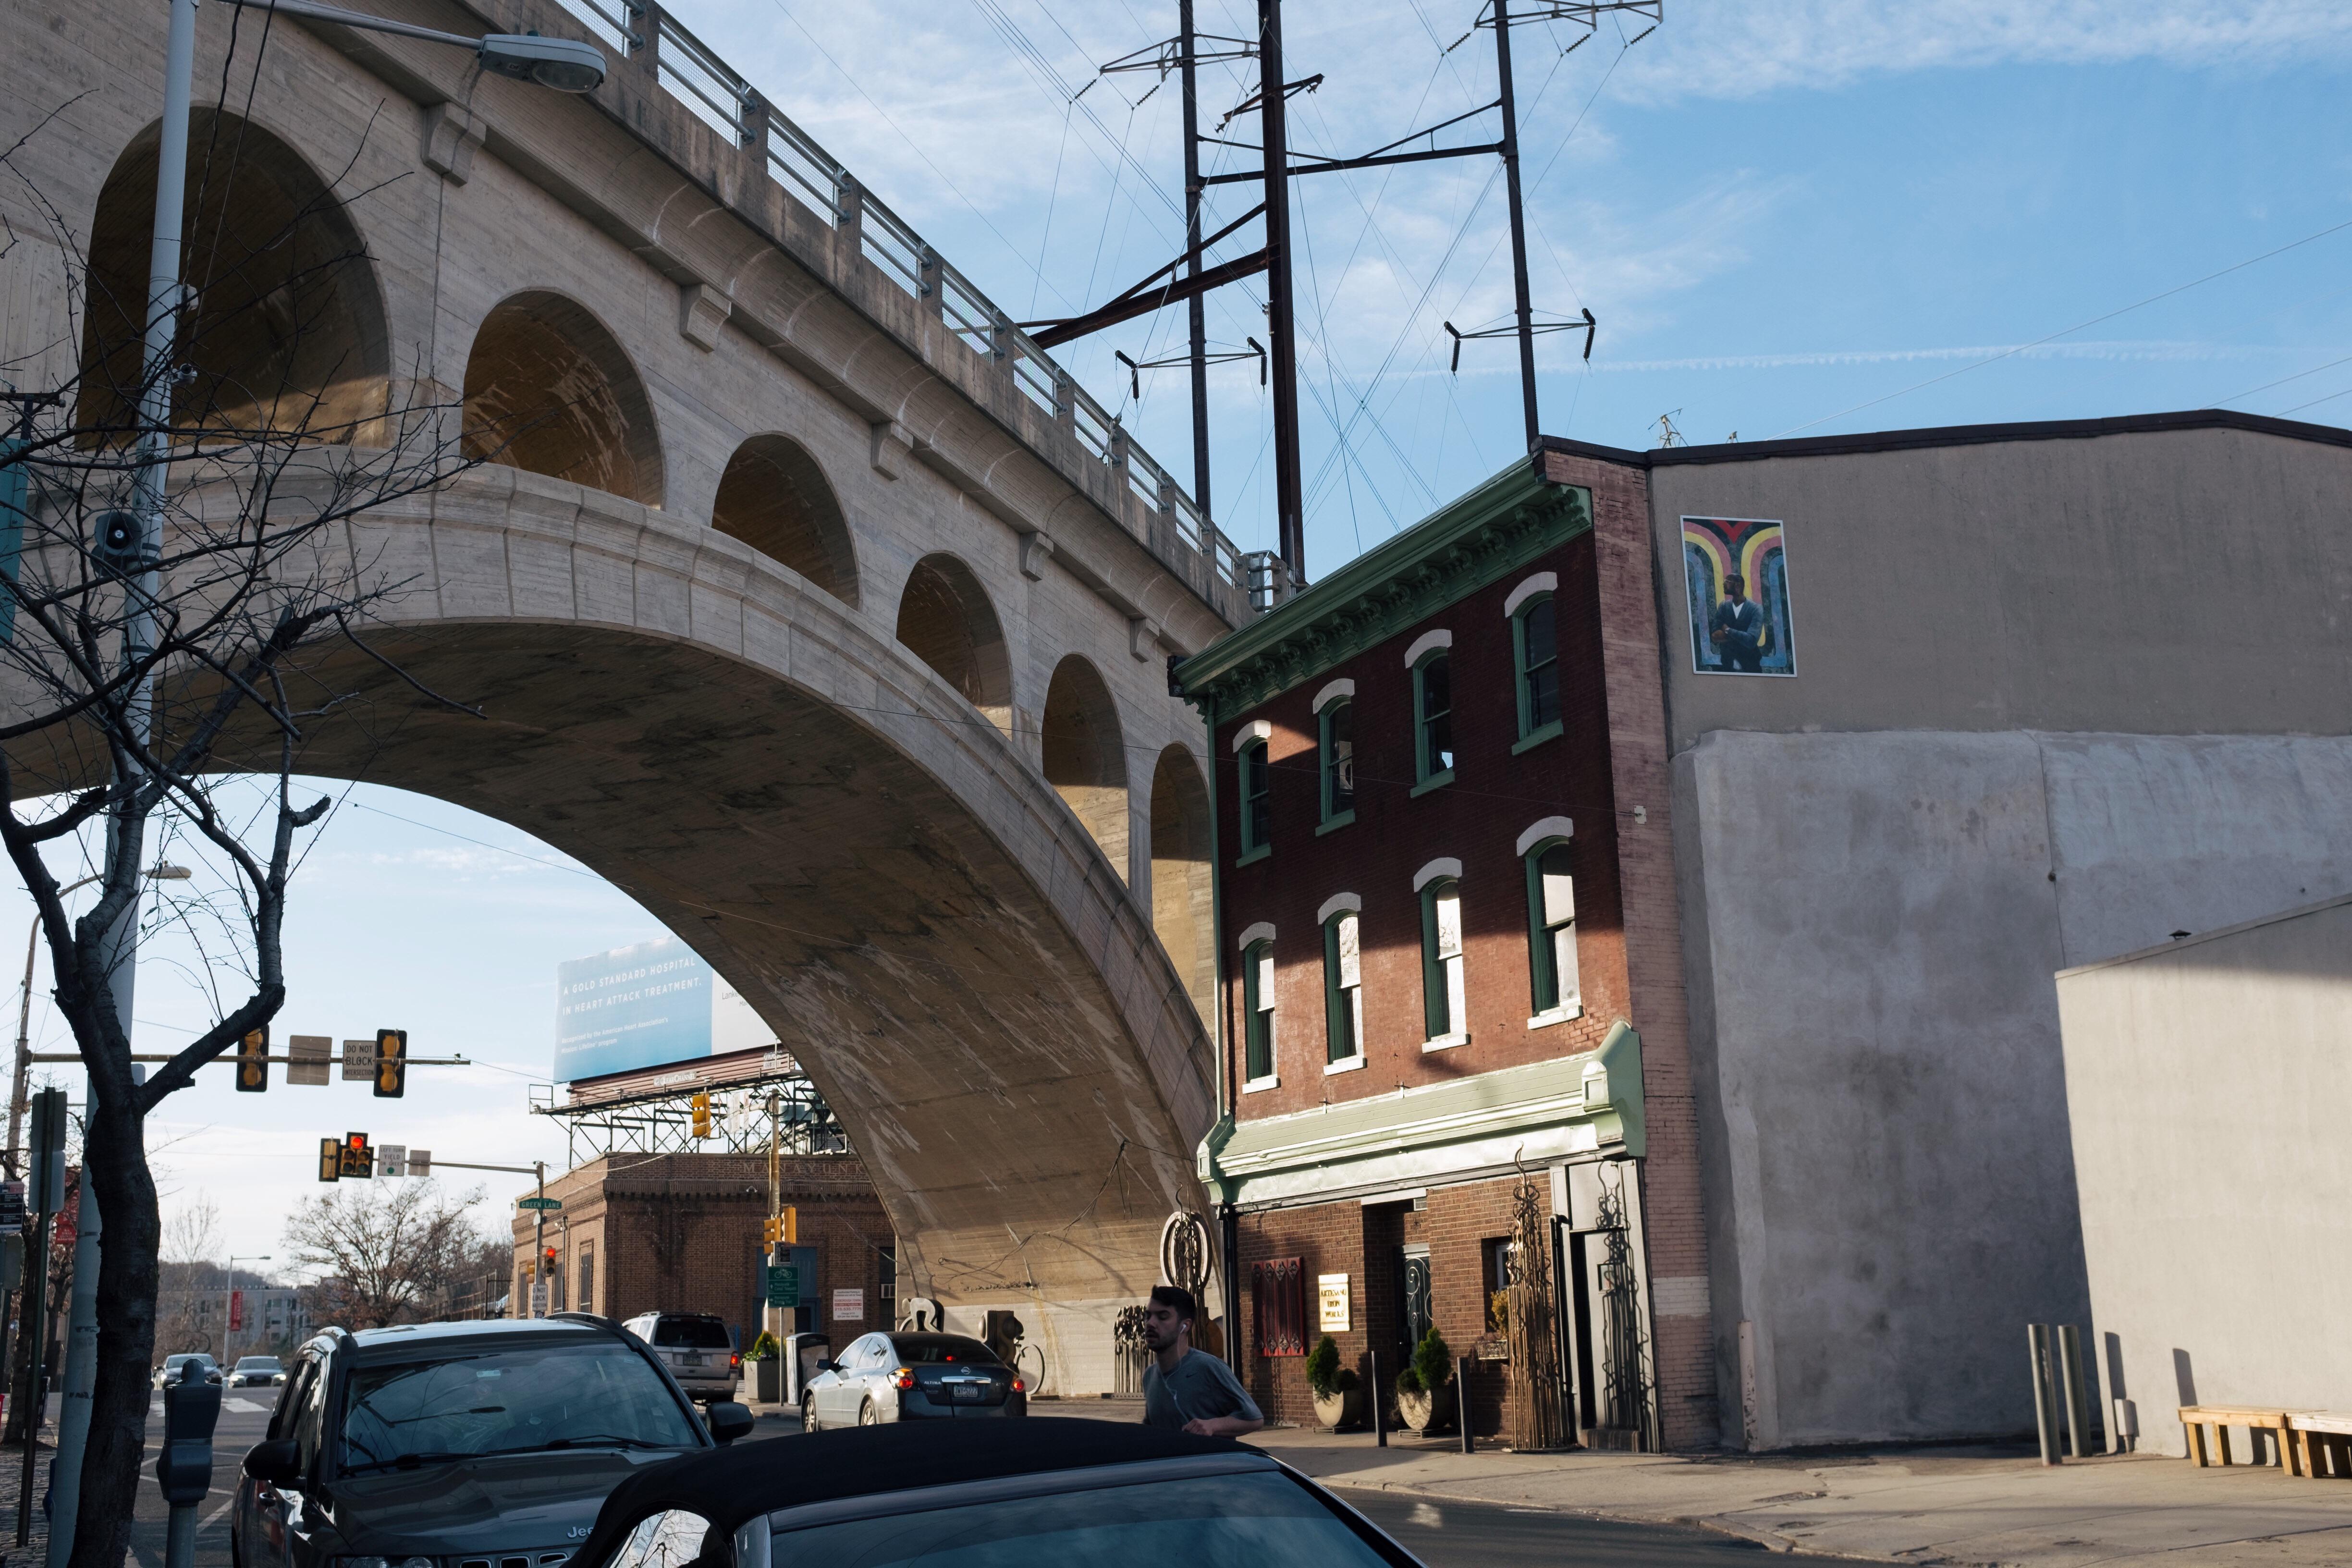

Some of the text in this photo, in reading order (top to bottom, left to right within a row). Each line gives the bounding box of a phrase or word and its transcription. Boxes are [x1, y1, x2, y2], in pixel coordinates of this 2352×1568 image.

[563, 956, 696, 996] A GOLD STANDARD HOSPITAL
[563, 977, 701, 1016] IN HEART ATTACK TREATMENT.
[562, 1033, 586, 1044] Recognized
[601, 1026, 623, 1035] American
[624, 1023, 637, 1031] Heart
[598, 1038, 618, 1047] program
[346, 1056, 372, 1066] BLOCK
[744, 1163, 863, 1173] MANAYUNK
